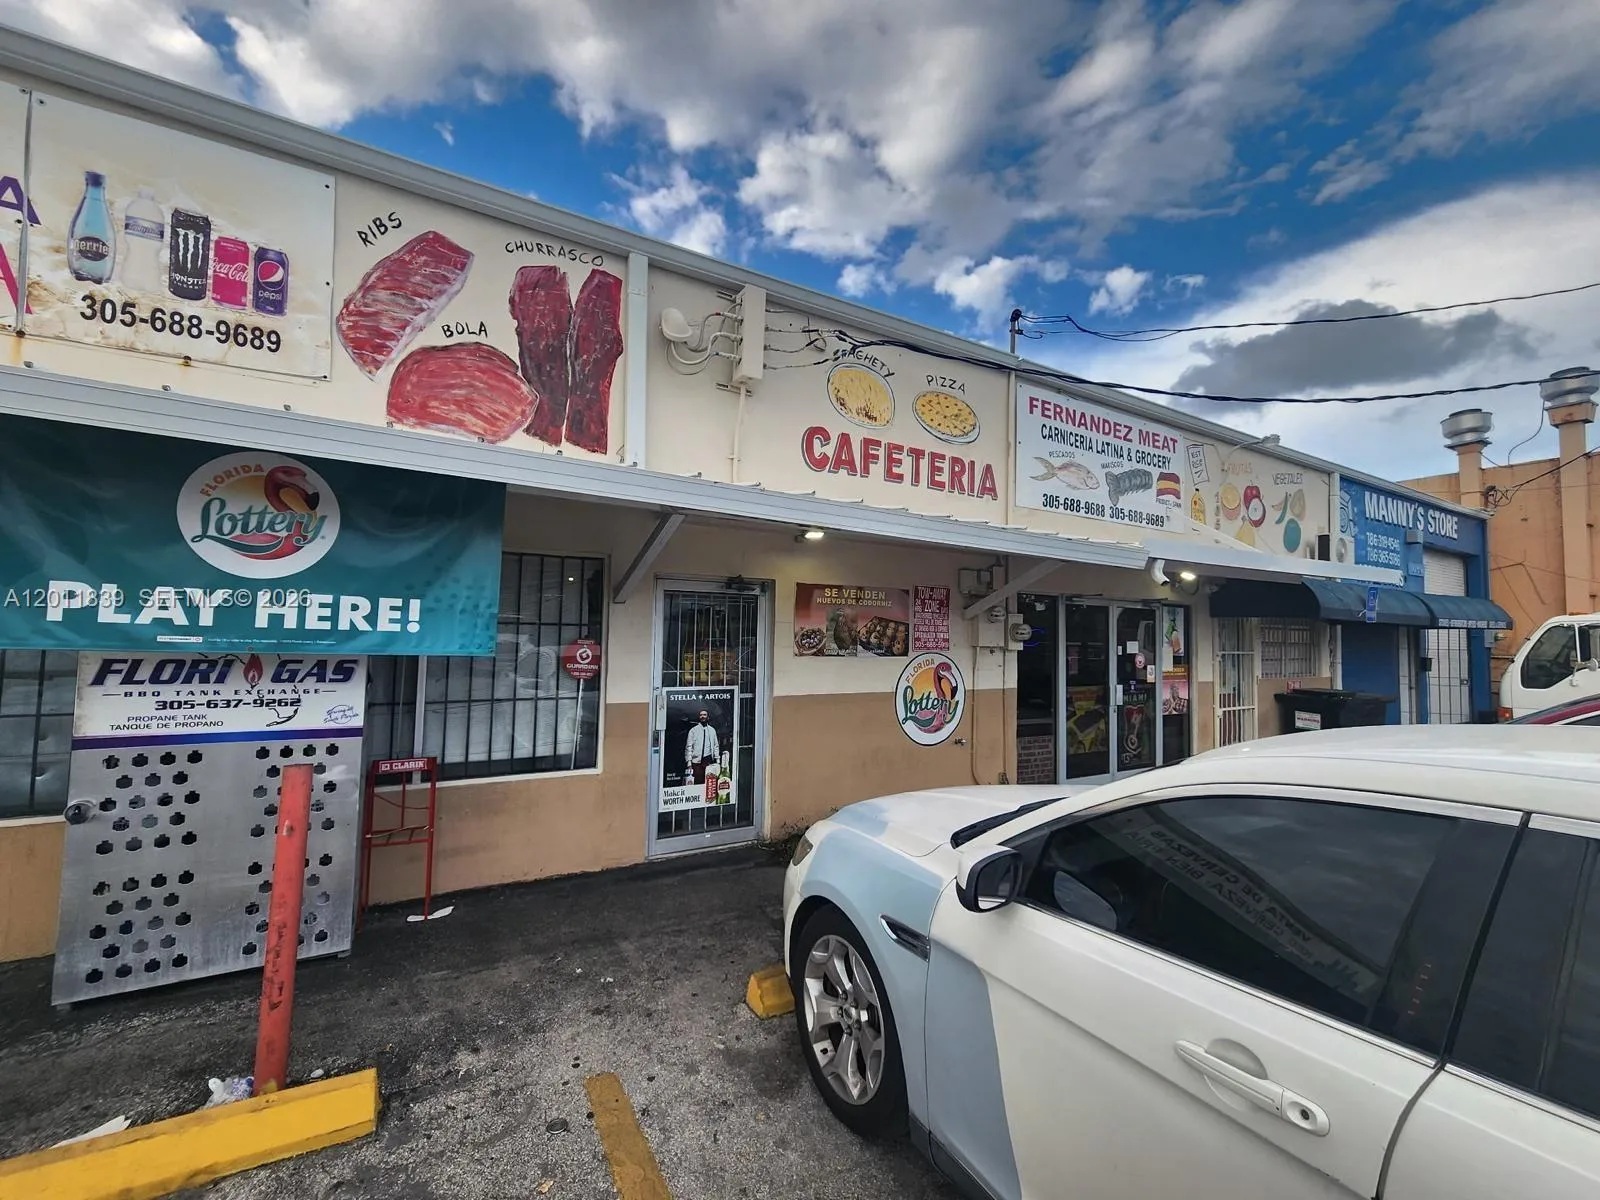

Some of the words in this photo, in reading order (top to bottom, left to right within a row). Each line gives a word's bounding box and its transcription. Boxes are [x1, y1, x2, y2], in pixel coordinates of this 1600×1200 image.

[357, 211, 402, 247] RIBS
[505, 241, 603, 267] CHURRASCO
[79, 294, 282, 353] 305-688-9689
[441, 321, 488, 338] BOLA
[926, 374, 966, 395] PIZZA
[1028, 396, 1133, 443] FERNANDEZ
[1138, 428, 1178, 454] MEAT
[1040, 423, 1093, 452] CARNICERIA
[1096, 439, 1124, 461] LATINA
[1127, 447, 1133, 462] &
[1135, 449, 1172, 471] GROCERY
[801, 426, 999, 501] CAFETERIA
[200, 464, 265, 497] FLORIDA
[1042, 493, 1106, 518] 305-688-9688
[1109, 506, 1165, 528] 305-688-9689
[1365, 491, 1424, 531] MANNY'S
[1427, 509, 1458, 540] STORE
[191, 497, 328, 552] Lottery
[46, 580, 233, 627] PLAY
[254, 591, 421, 633] HERE!
[816, 597, 846, 605] HUEVOS
[824, 588, 839, 597] SE
[842, 589, 886, 600] VENDEN
[924, 600, 940, 612] ZONE
[90, 658, 236, 686] FLORI
[270, 659, 360, 683] GAS
[905, 659, 935, 684] FLORIDA
[155, 698, 302, 711] 305-637-9262
[233, 688, 321, 696] EXCHANGE
[127, 715, 178, 723] PROPANE
[902, 685, 959, 727] Lottery
[110, 723, 152, 731] TANQUE
[174, 721, 224, 729] PROPANO
[663, 797, 684, 806] WORTH
[685, 795, 701, 803] MORE
